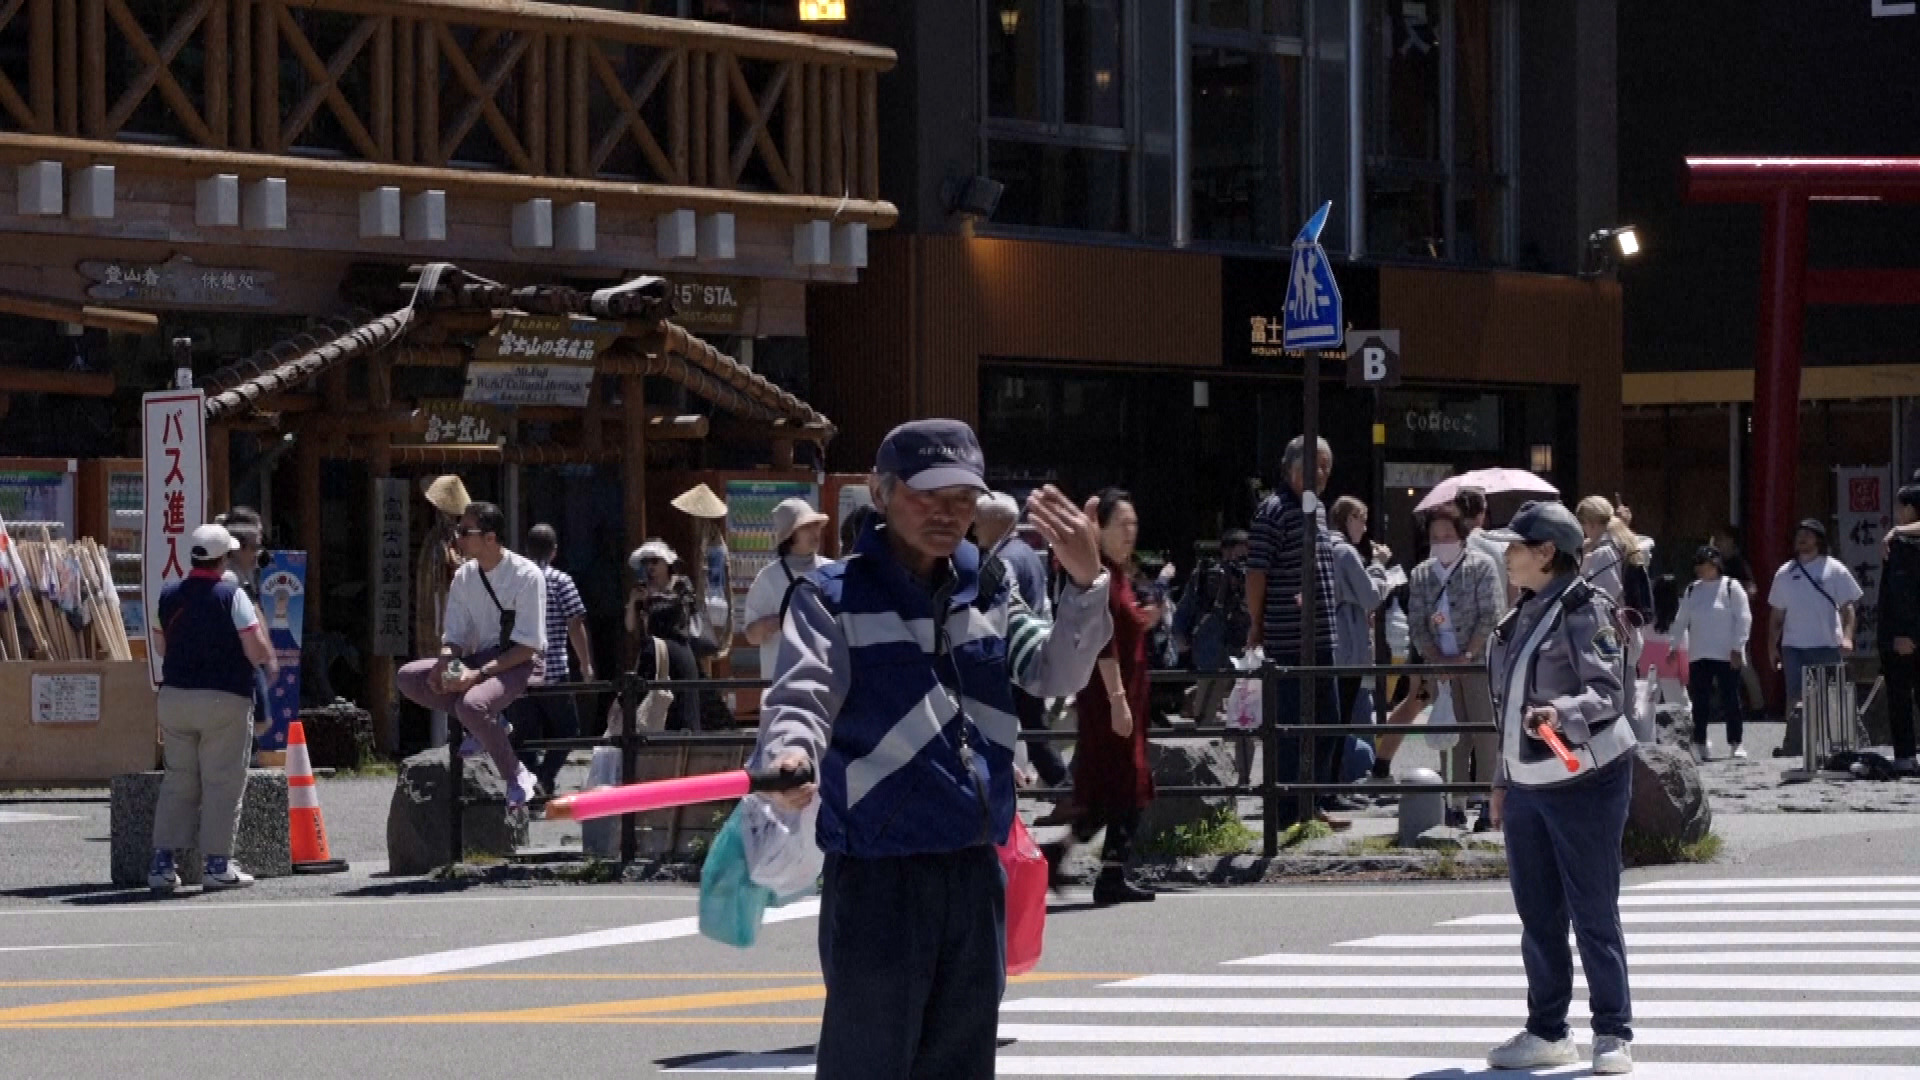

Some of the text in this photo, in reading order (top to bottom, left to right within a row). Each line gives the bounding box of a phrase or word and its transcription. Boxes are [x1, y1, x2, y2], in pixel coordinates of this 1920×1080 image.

[704, 286, 738, 306] STA.
[1250, 316, 1284, 344] 富士
[499, 331, 595, 361] 富士山の名産品
[1363, 347, 1387, 381] B
[424, 414, 491, 442] 富士登山
[162, 408, 185, 579] バス進入
